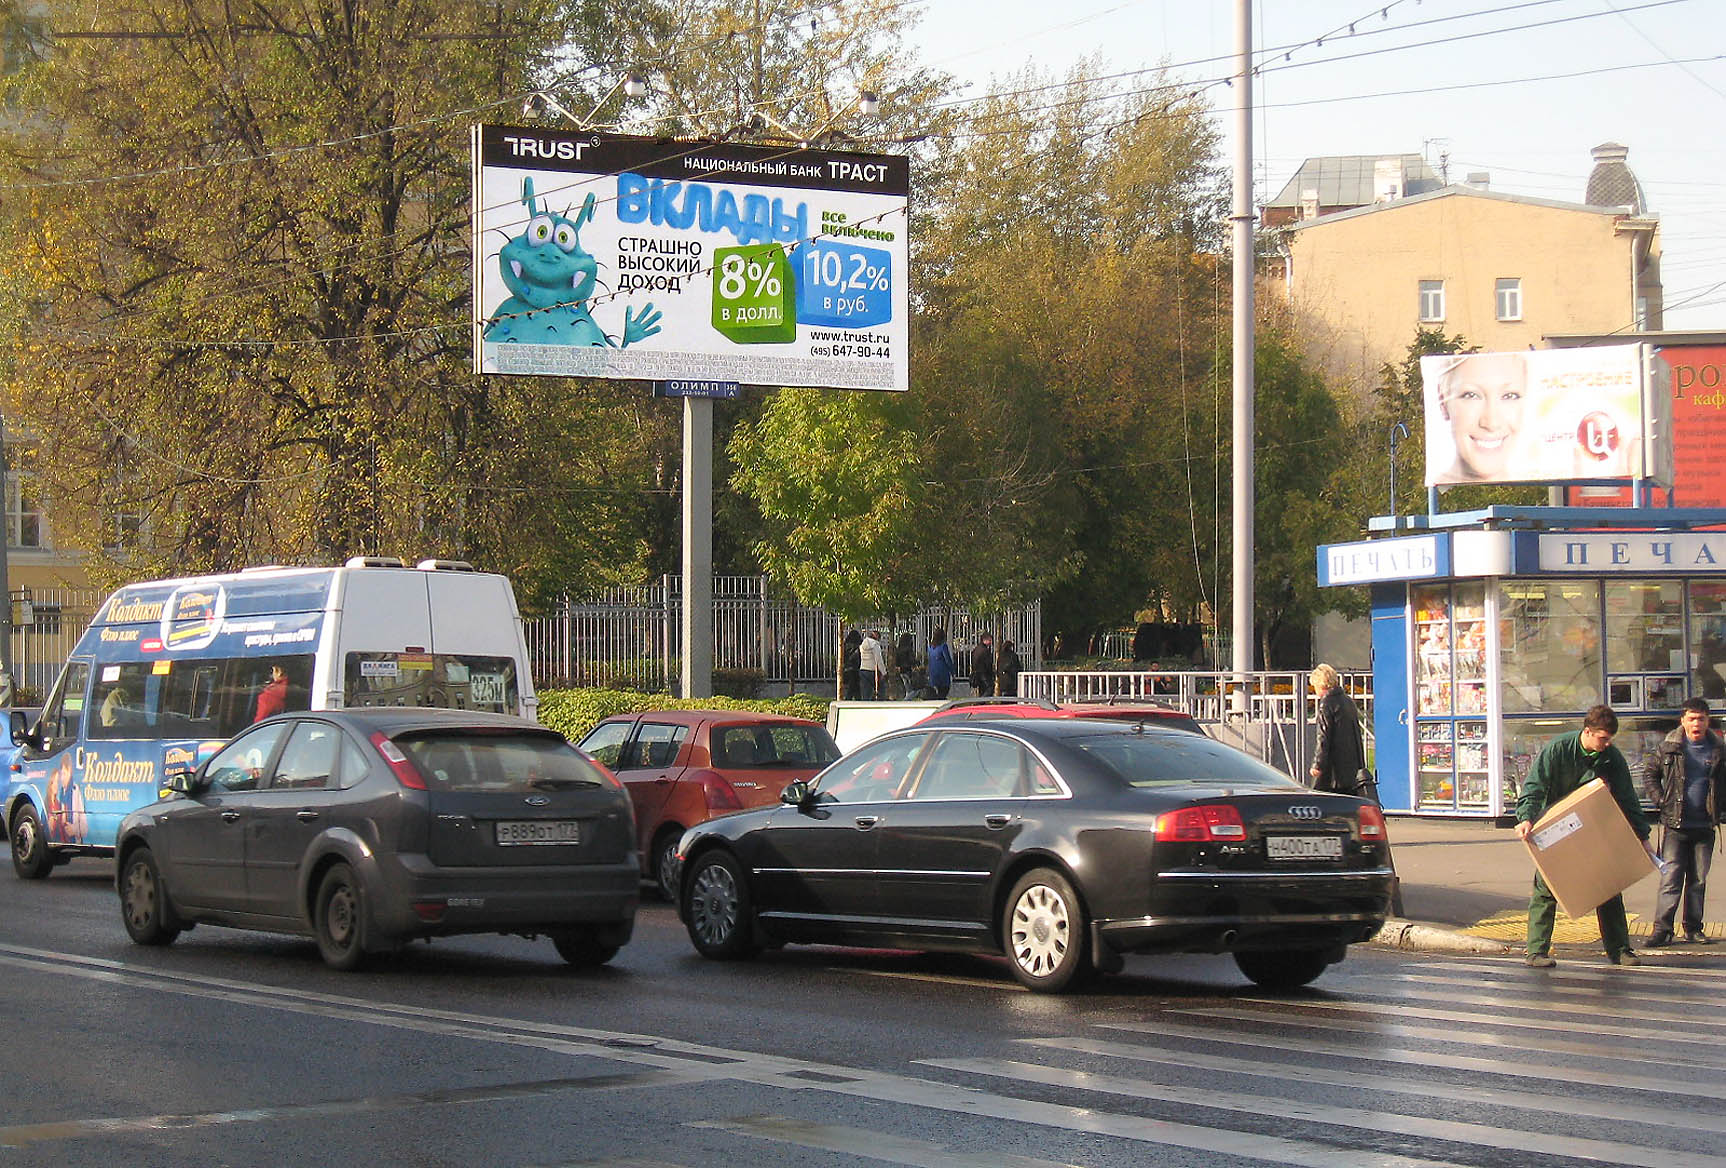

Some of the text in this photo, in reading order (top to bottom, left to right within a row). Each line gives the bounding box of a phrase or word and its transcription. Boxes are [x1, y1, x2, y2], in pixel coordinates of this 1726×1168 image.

[504, 136, 590, 160] TRUST
[684, 157, 888, 182] НАЦИОНАЛЬНЫЙ БАНК ТРАСТ
[617, 172, 808, 245] ВКЛАДЫ
[822, 224, 895, 242] включено
[618, 237, 702, 256] СТРАШНО
[618, 255, 700, 273] ВЫСОКИЙ
[807, 250, 889, 295] 10,2%
[617, 274, 682, 294] ДОХОД
[719, 254, 782, 300] 8%
[722, 307, 782, 324] в долл.
[823, 295, 869, 316] в руб.
[810, 330, 890, 345] www.trust.ru
[810, 345, 890, 359] (495) 647-90-44
[671, 381, 719, 391] ОЛИМП
[1693, 390, 1726, 410] каф
[1333, 547, 1433, 577] ПЕЧАТЬ
[1564, 542, 1717, 565] ПЕЧА
[106, 597, 163, 623] Колдакт
[82, 751, 155, 784] Колдакт
